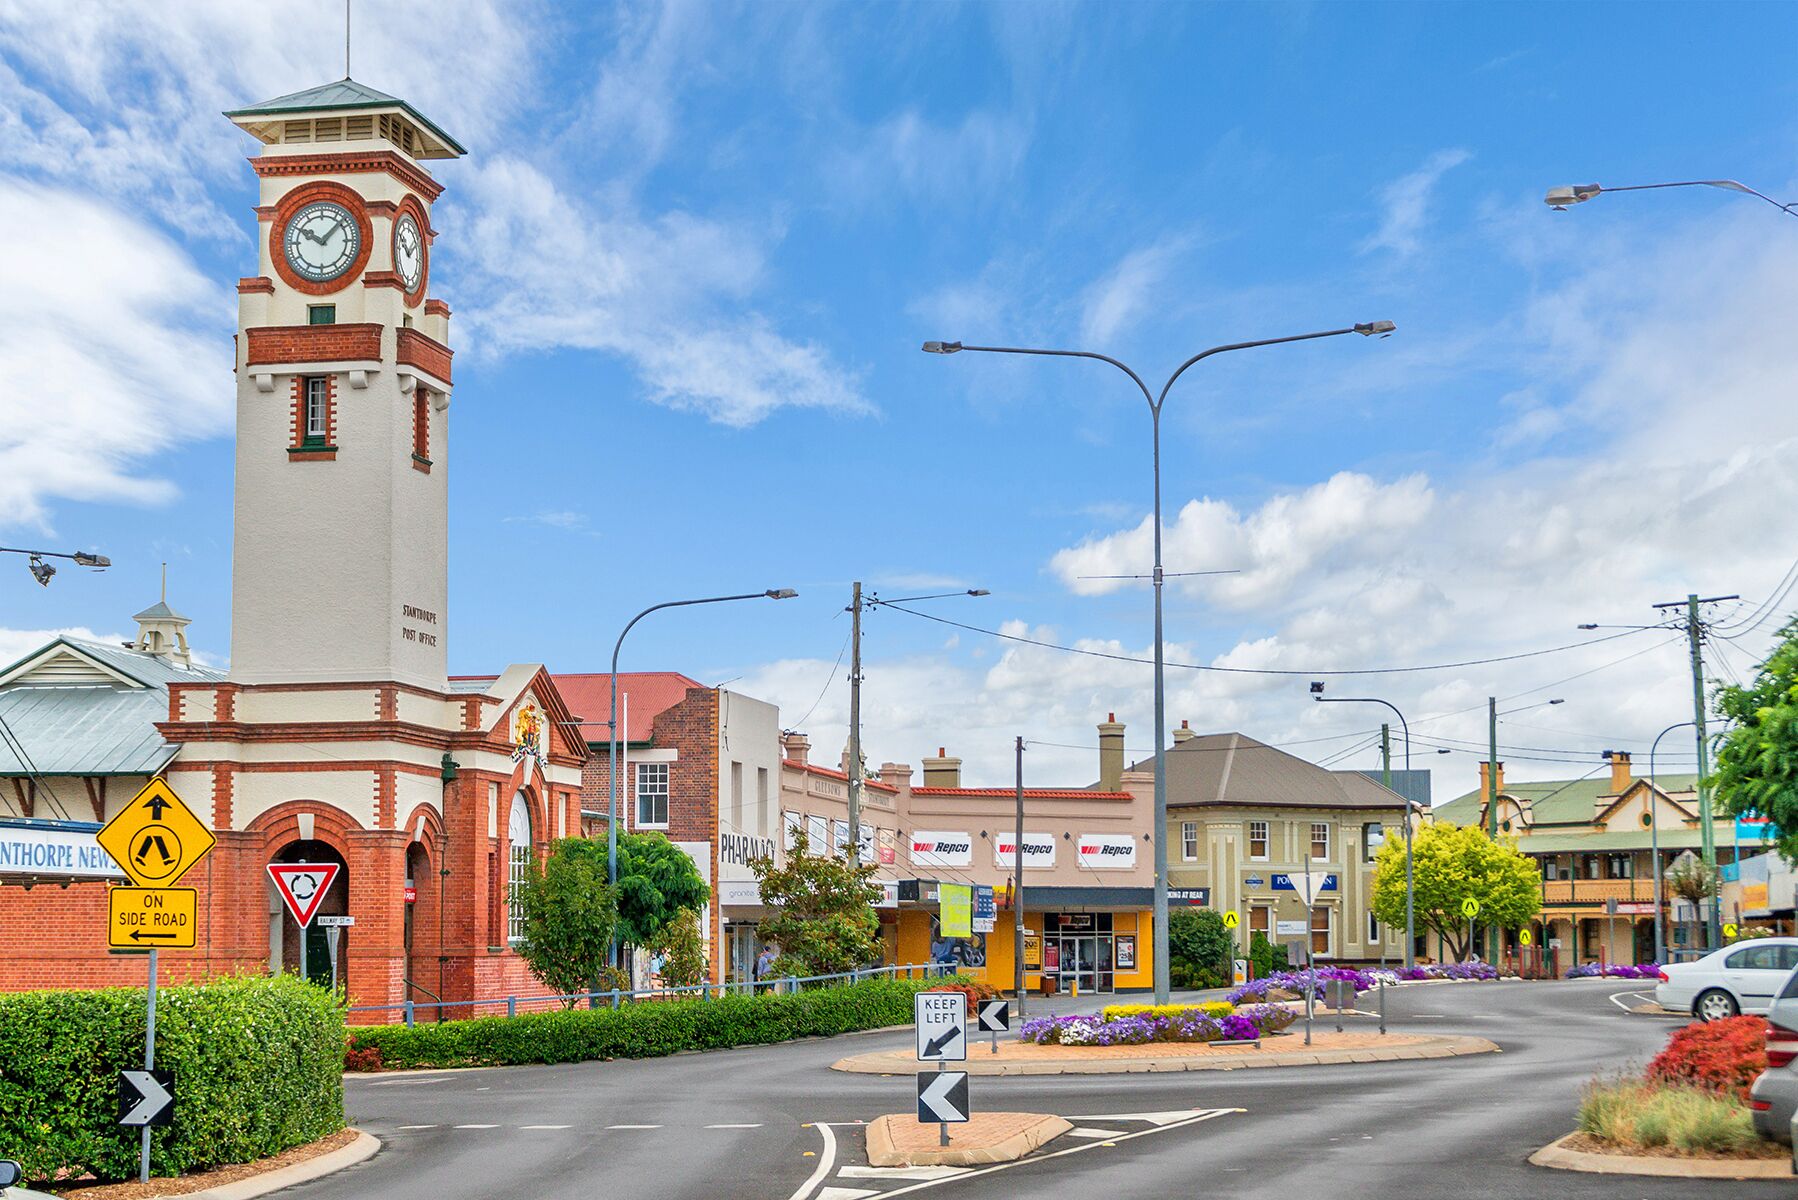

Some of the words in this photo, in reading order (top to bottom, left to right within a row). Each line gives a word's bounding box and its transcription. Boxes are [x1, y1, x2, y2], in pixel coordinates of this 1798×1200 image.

[402, 604, 437, 625] STANTHORPE
[402, 627, 416, 641] POST
[419, 632, 437, 647] OFFICE
[935, 842, 969, 855] Repco
[1021, 843, 1053, 856] Repco
[1101, 845, 1133, 857] Repco
[143, 894, 163, 909] ON
[119, 912, 146, 926] SIDE
[153, 913, 187, 927] ROAD
[925, 999, 957, 1010] KEEP
[926, 1013, 956, 1024] LEFT
